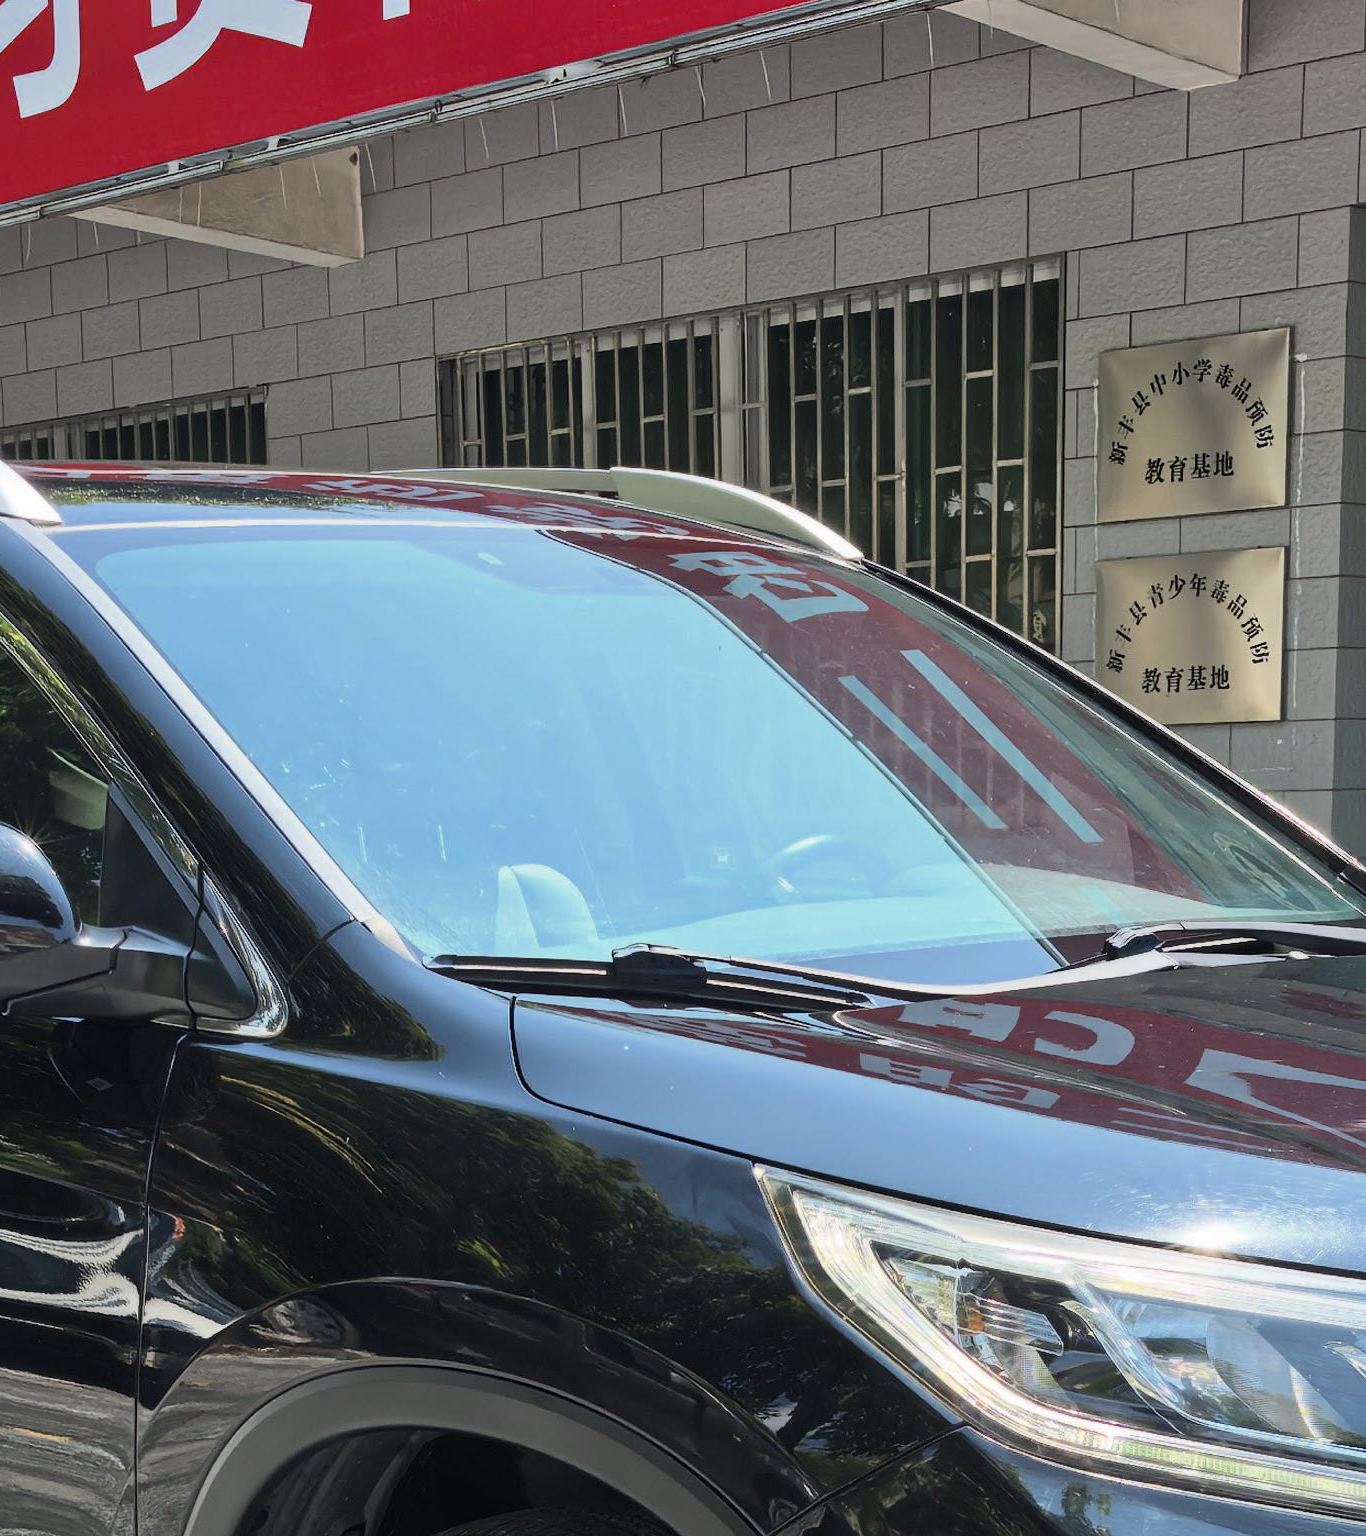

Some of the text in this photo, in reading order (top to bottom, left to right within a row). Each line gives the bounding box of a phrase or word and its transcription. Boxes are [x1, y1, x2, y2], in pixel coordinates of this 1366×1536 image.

[1108, 358, 1275, 466] 新丰县中小学毒品预防
[1145, 450, 1235, 484] 教育基地
[1106, 573, 1270, 673] 新丰县青少年毒品预防
[1142, 664, 1231, 694] 教育基地
